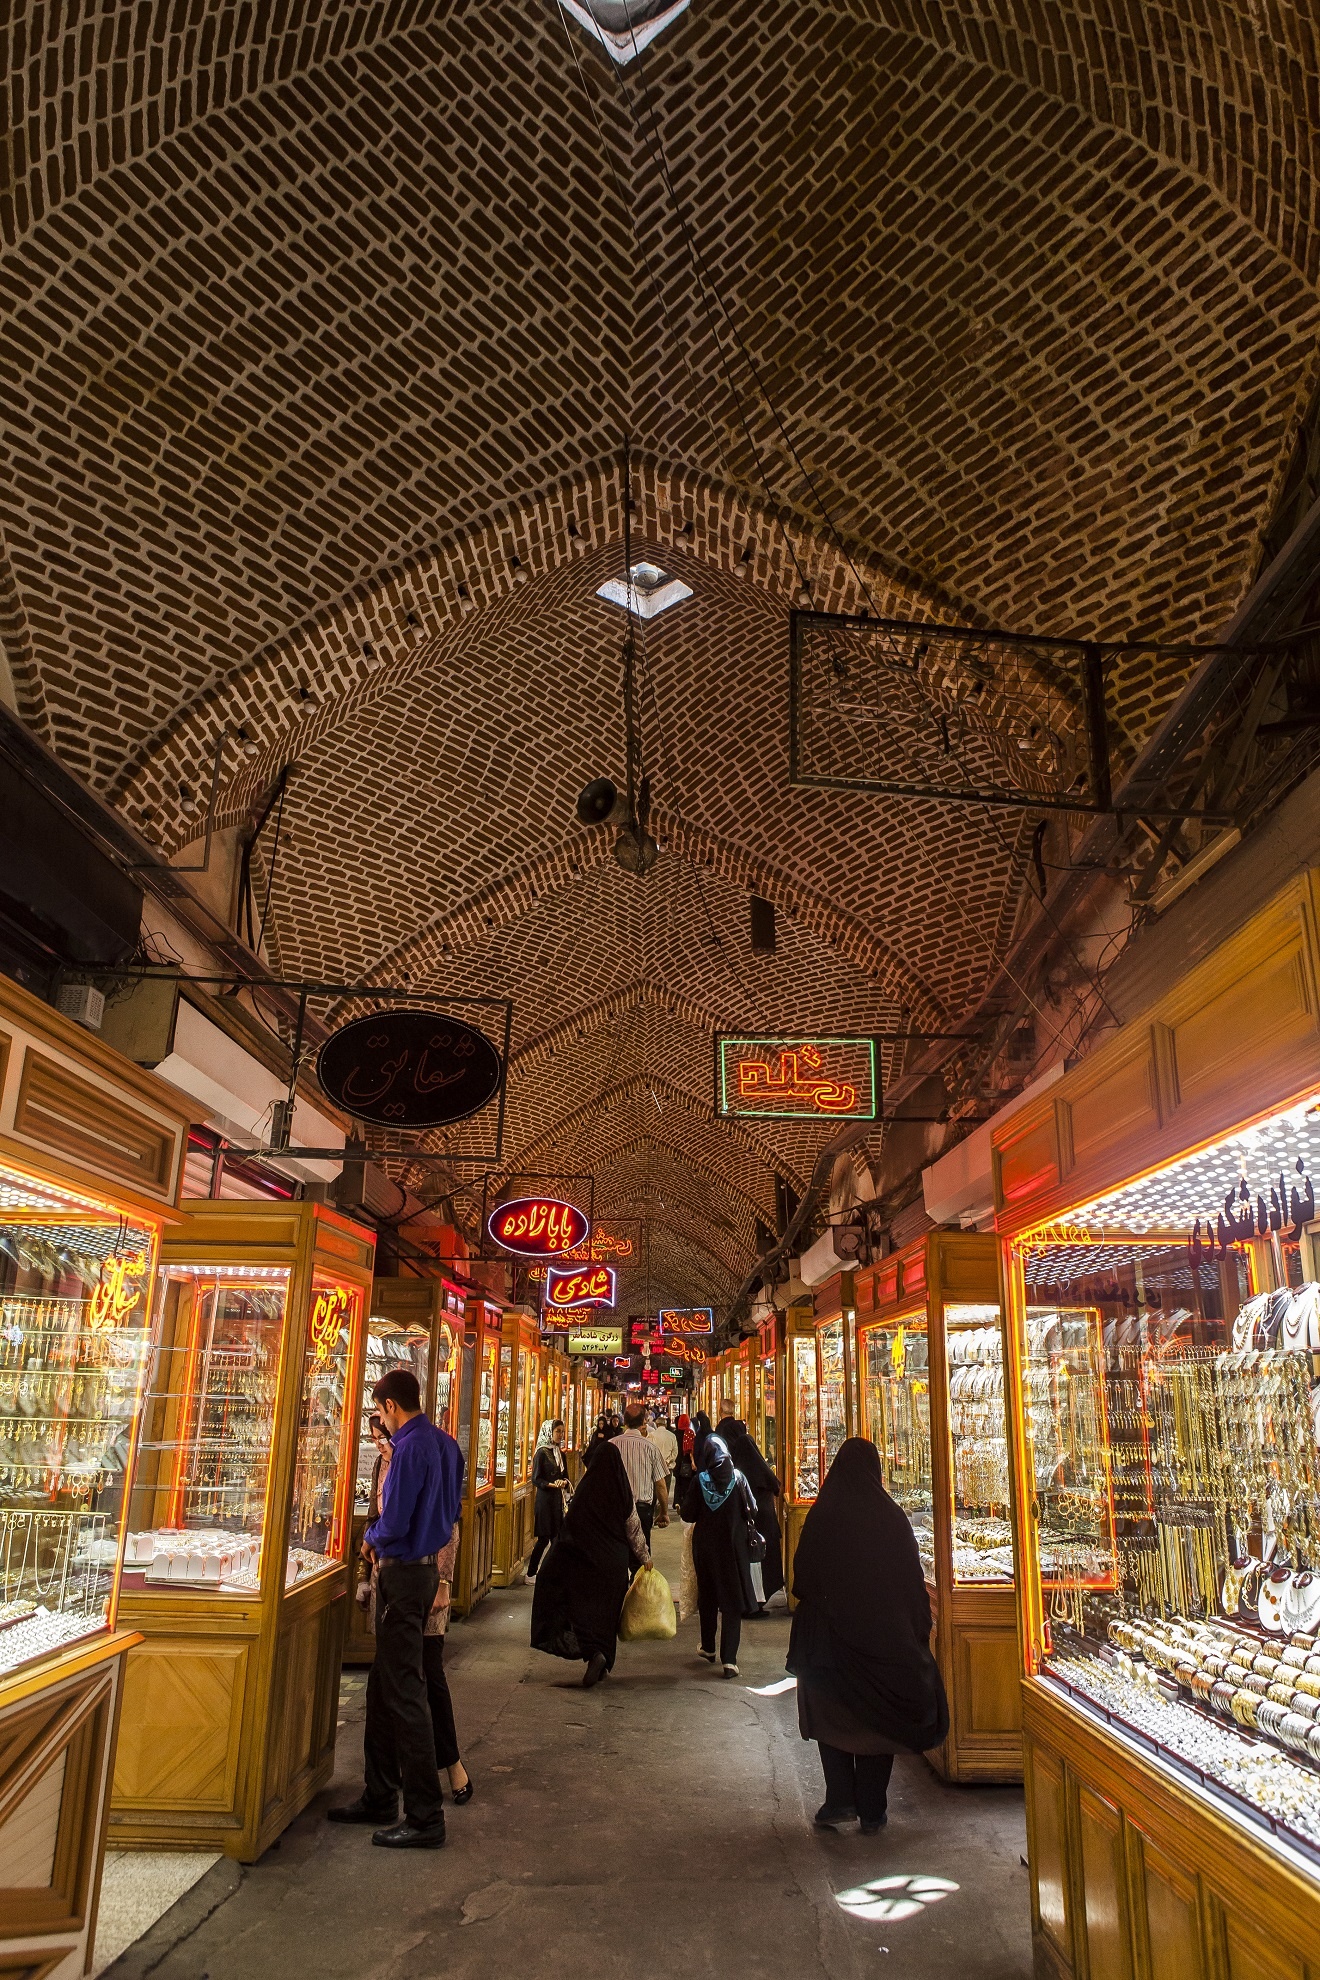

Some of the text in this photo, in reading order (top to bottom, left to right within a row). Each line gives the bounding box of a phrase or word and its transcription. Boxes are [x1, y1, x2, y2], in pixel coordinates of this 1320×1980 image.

[341, 1033, 476, 1117] شقایق
[503, 1205, 572, 1248] بابازاده
[1187, 1177, 1254, 1270] شکوری
[553, 1270, 608, 1303] شادی
[599, 1331, 619, 1342] زرگری
